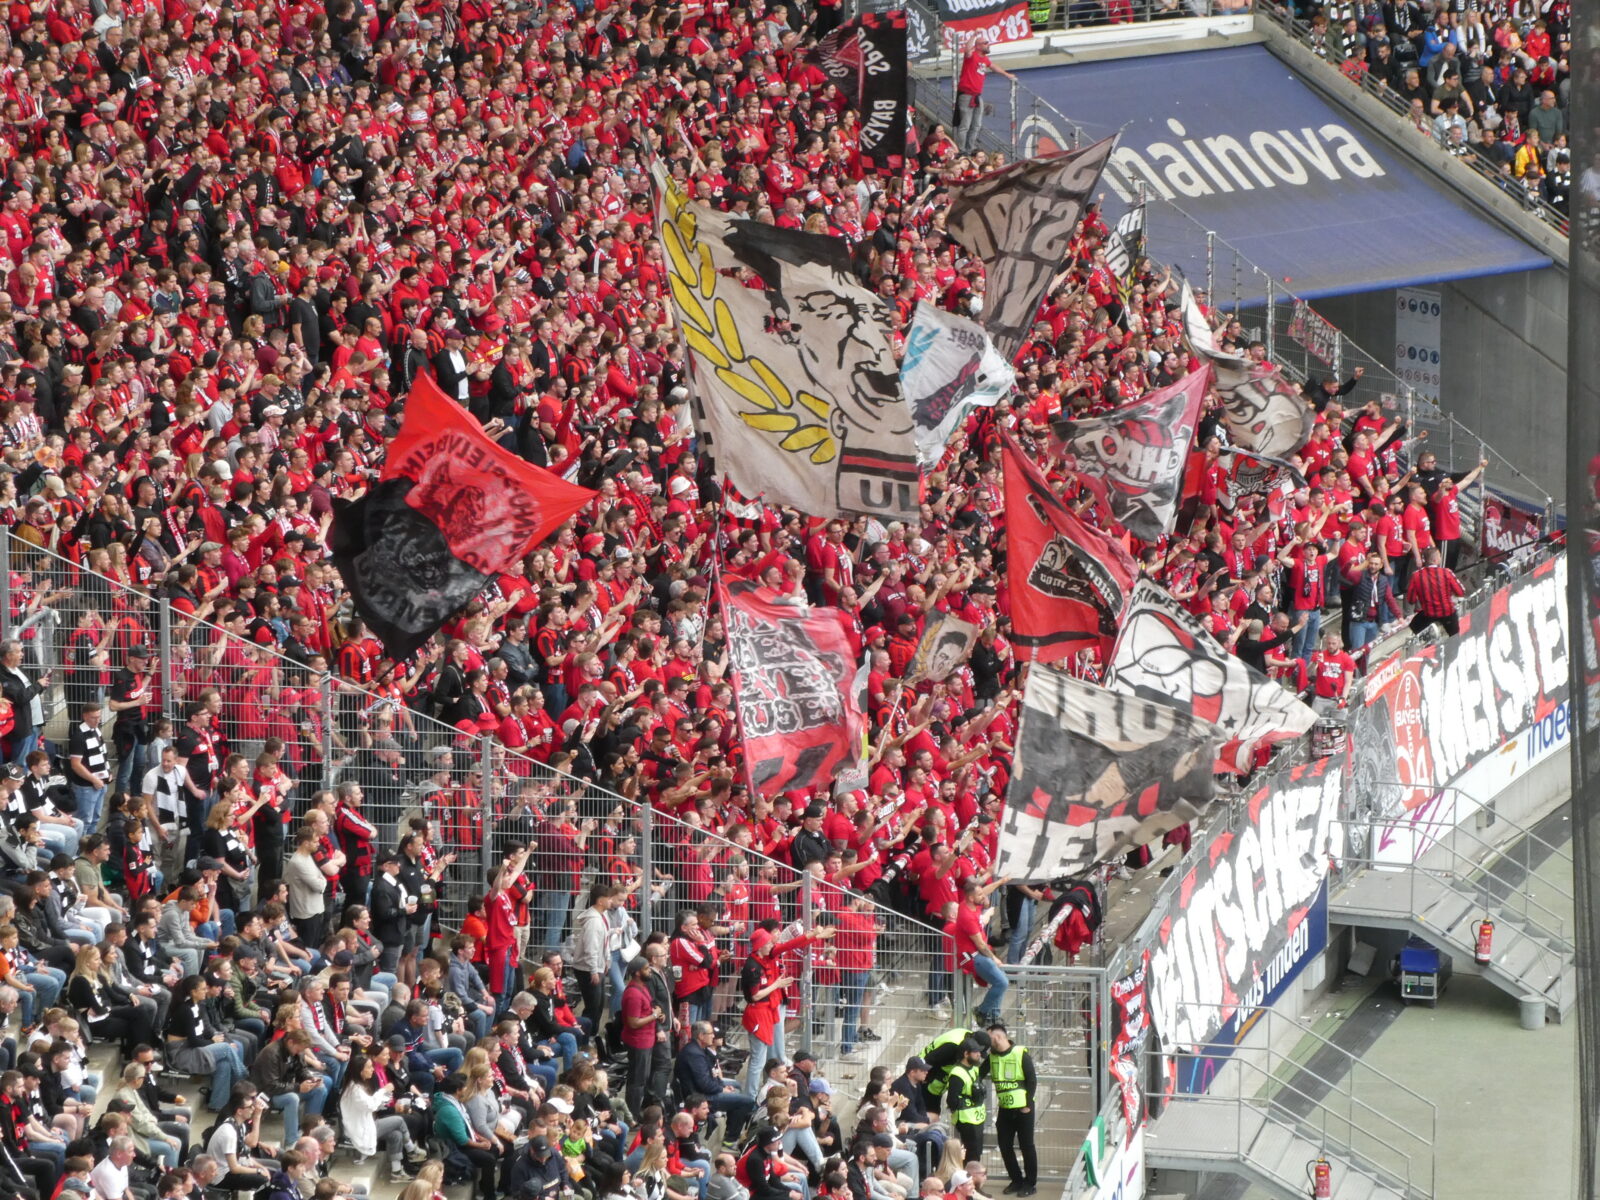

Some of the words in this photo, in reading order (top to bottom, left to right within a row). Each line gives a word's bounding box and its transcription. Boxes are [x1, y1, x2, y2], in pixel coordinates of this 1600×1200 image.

[1101, 118, 1387, 205] mainova
[1421, 553, 1569, 787] MEISTE
[1395, 708, 1421, 727] BAYER
